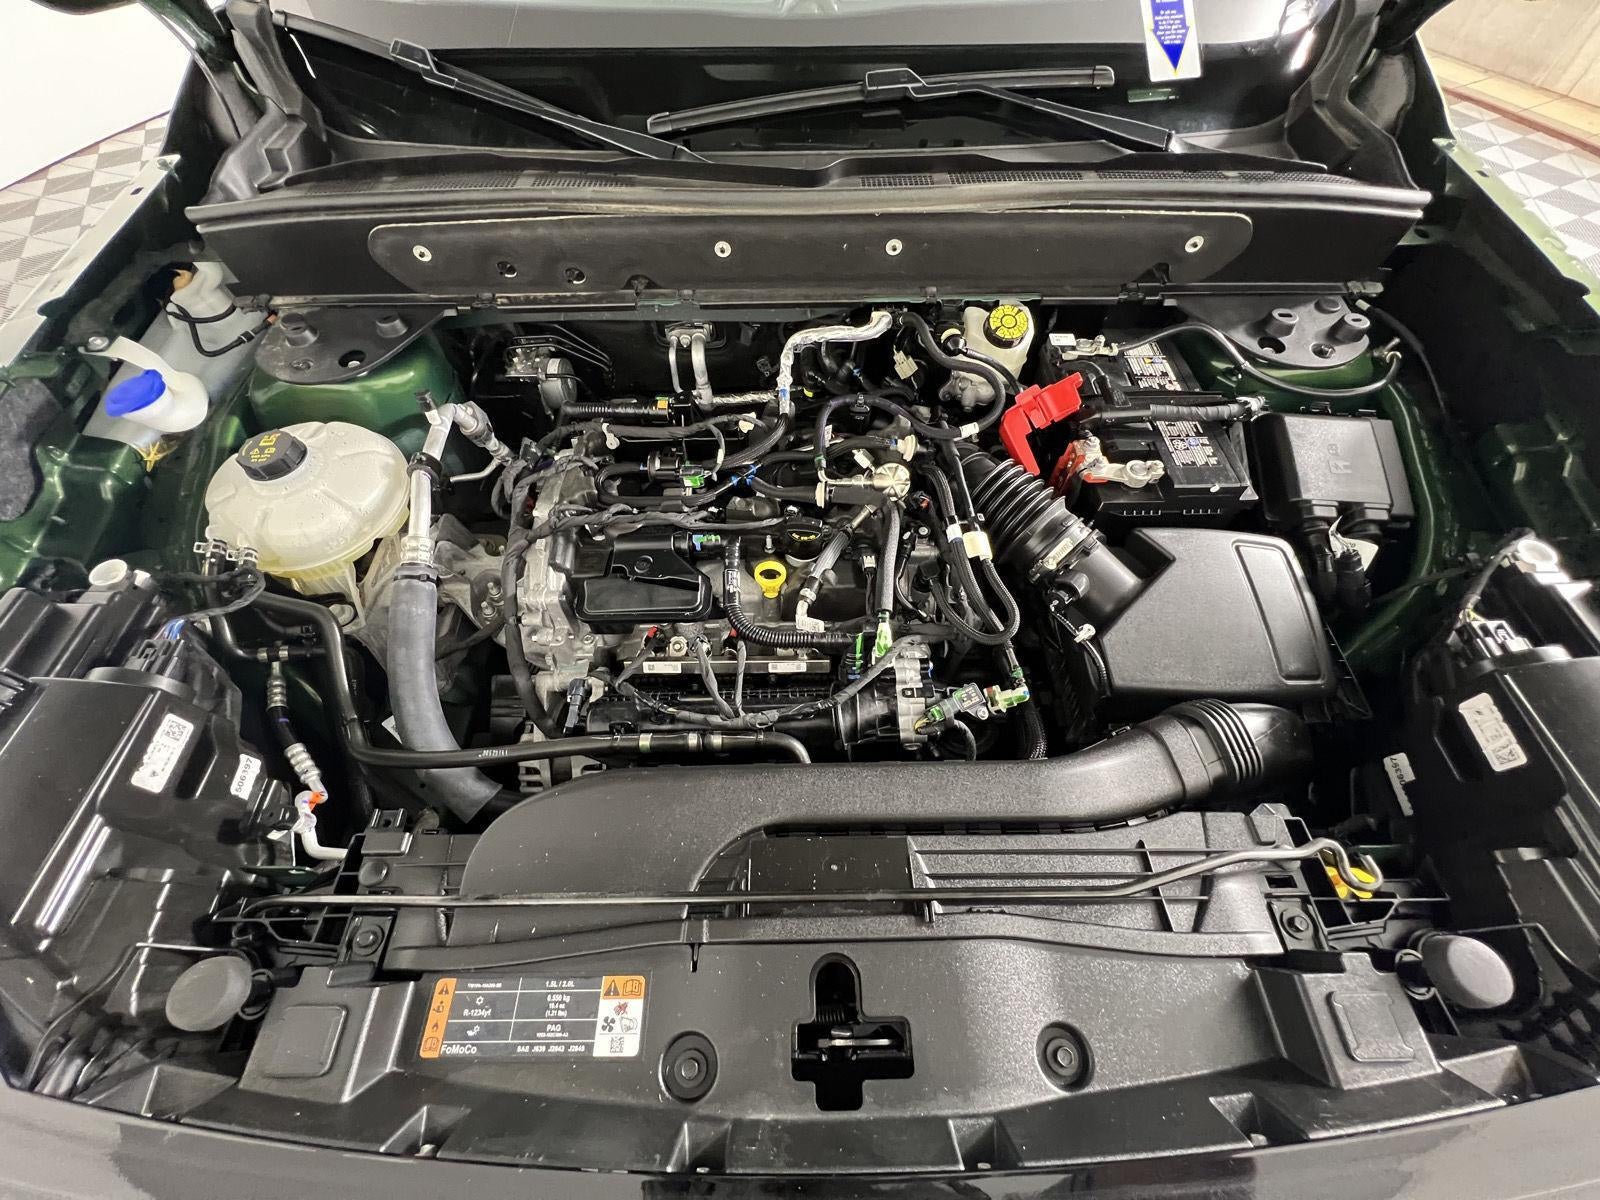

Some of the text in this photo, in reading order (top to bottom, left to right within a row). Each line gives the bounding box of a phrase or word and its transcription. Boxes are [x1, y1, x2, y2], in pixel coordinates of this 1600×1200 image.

[235, 757, 253, 793] 506397
[1389, 757, 1406, 791] 06397
[463, 1008, 492, 1018] R-1234yf
[546, 1023, 561, 1032] PAG
[440, 1044, 477, 1055] FoMoCo
